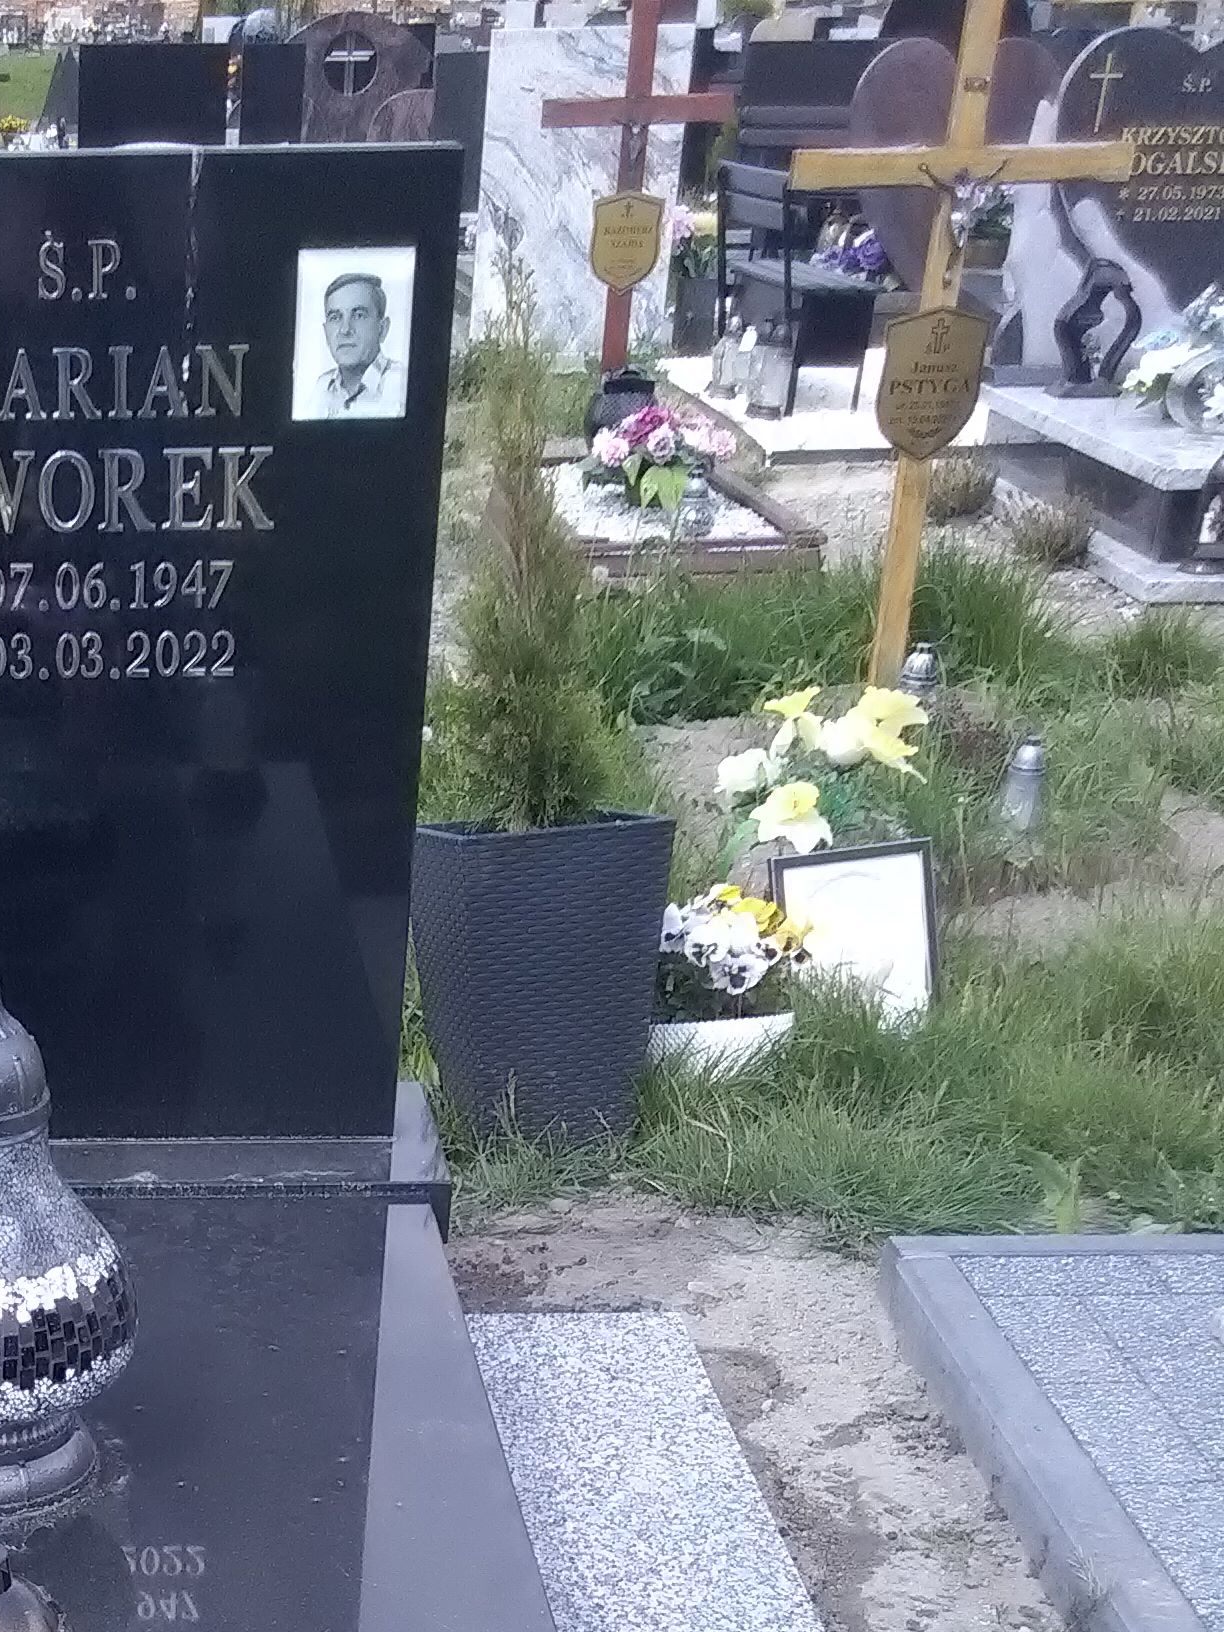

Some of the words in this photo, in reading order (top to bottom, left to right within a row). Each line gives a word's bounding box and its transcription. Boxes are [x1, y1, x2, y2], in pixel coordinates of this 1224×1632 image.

[1130, 151, 1224, 176] OGALS
[38, 230, 136, 301] Ś.P.
[889, 377, 969, 395] PSTYGA
